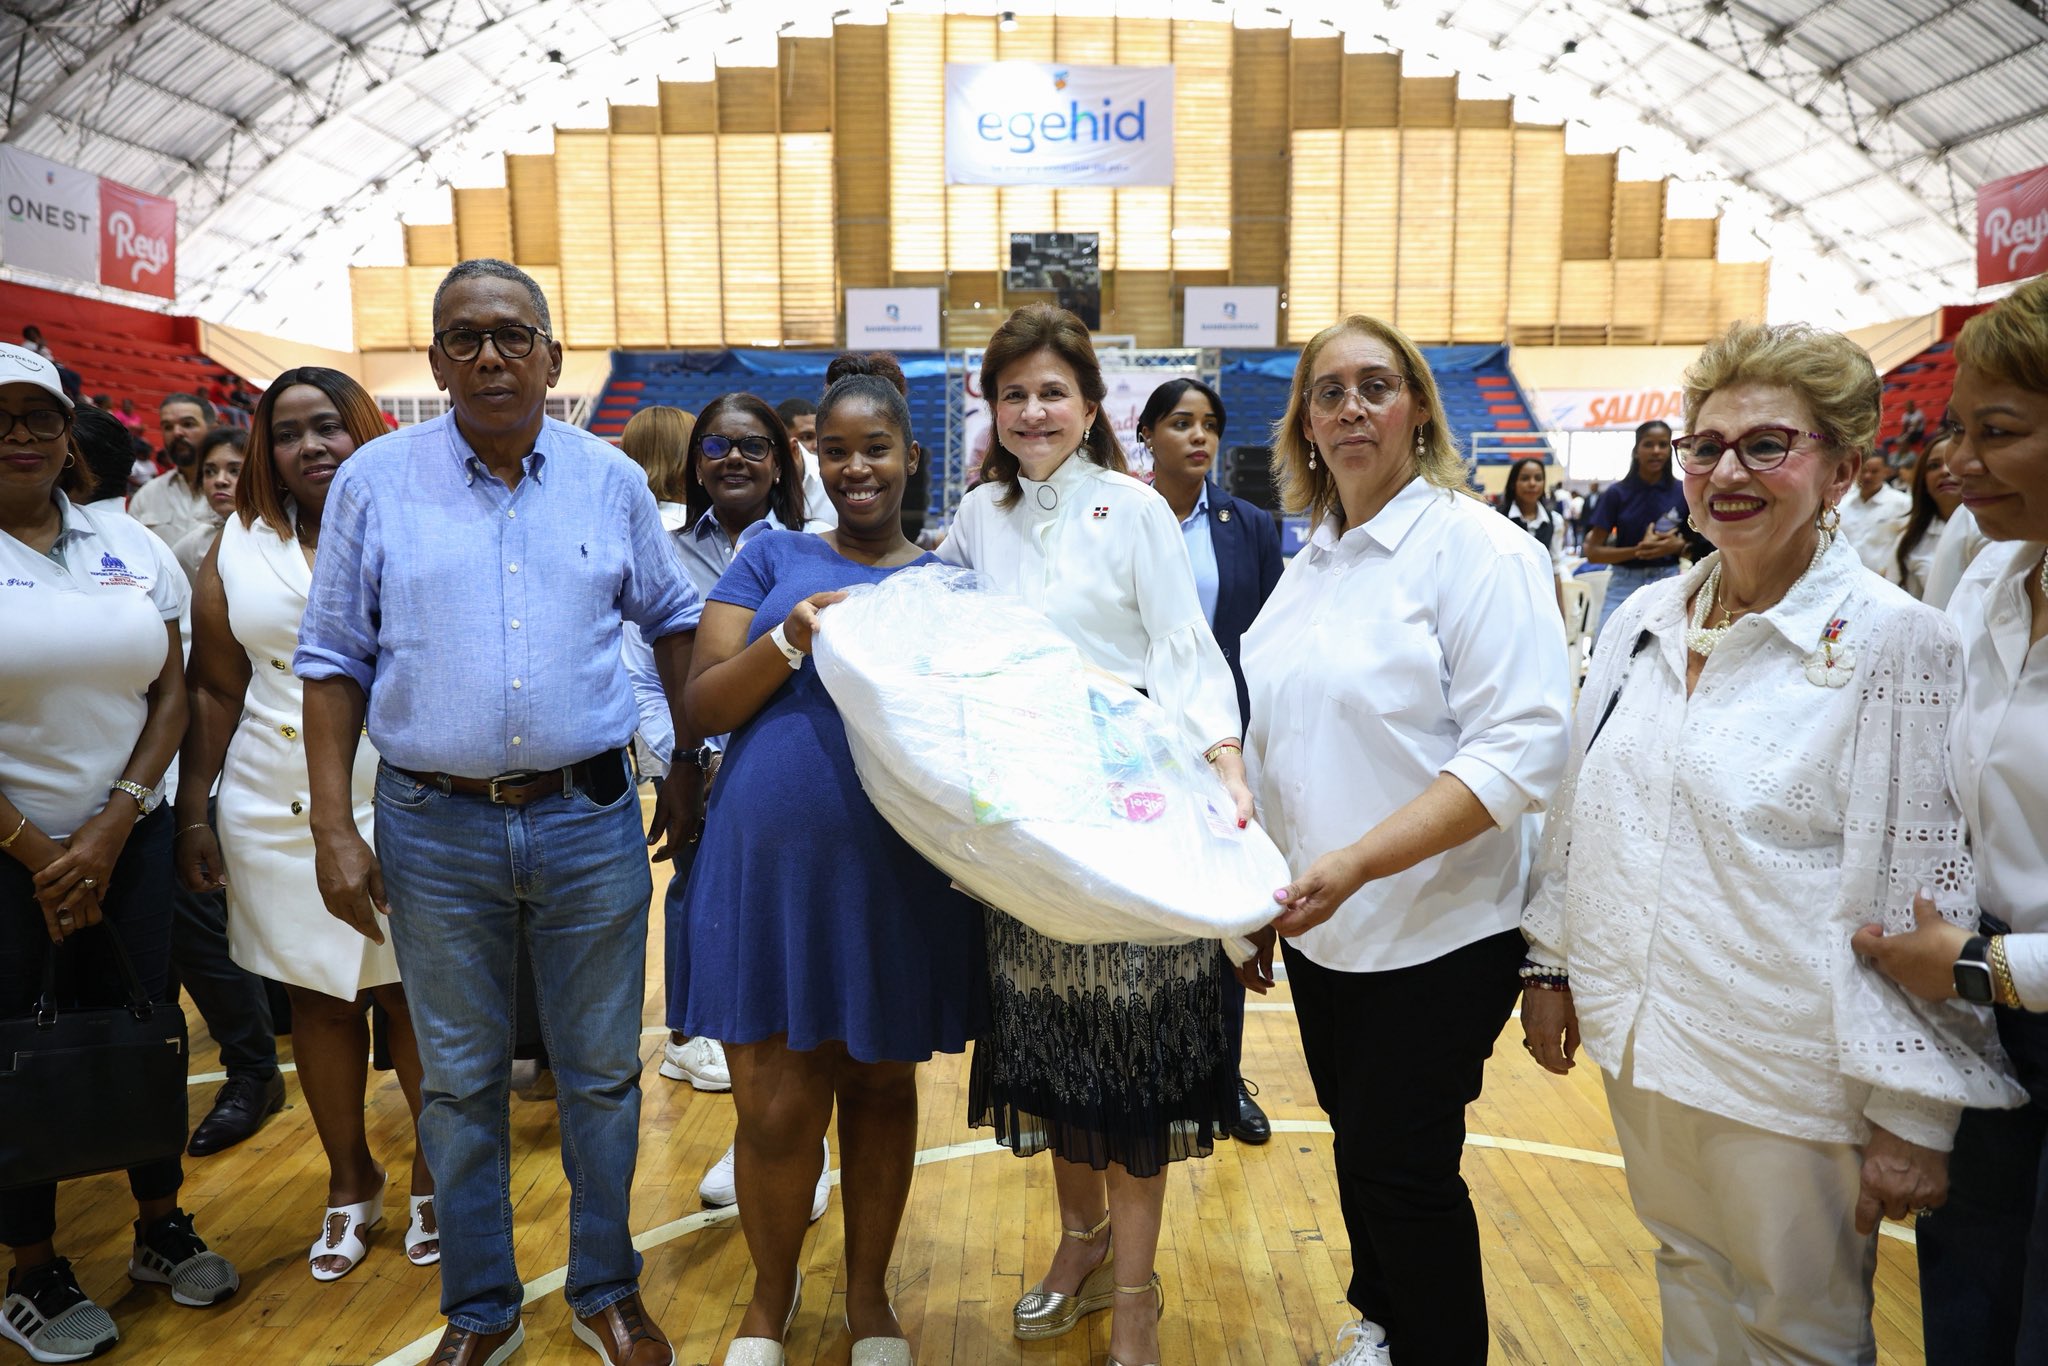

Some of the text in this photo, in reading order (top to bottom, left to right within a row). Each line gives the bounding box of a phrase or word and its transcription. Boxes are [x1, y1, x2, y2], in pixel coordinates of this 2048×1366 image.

[977, 97, 1146, 154] egehid
[8, 194, 91, 235] ONEST
[1584, 390, 1682, 428] SALIDA
